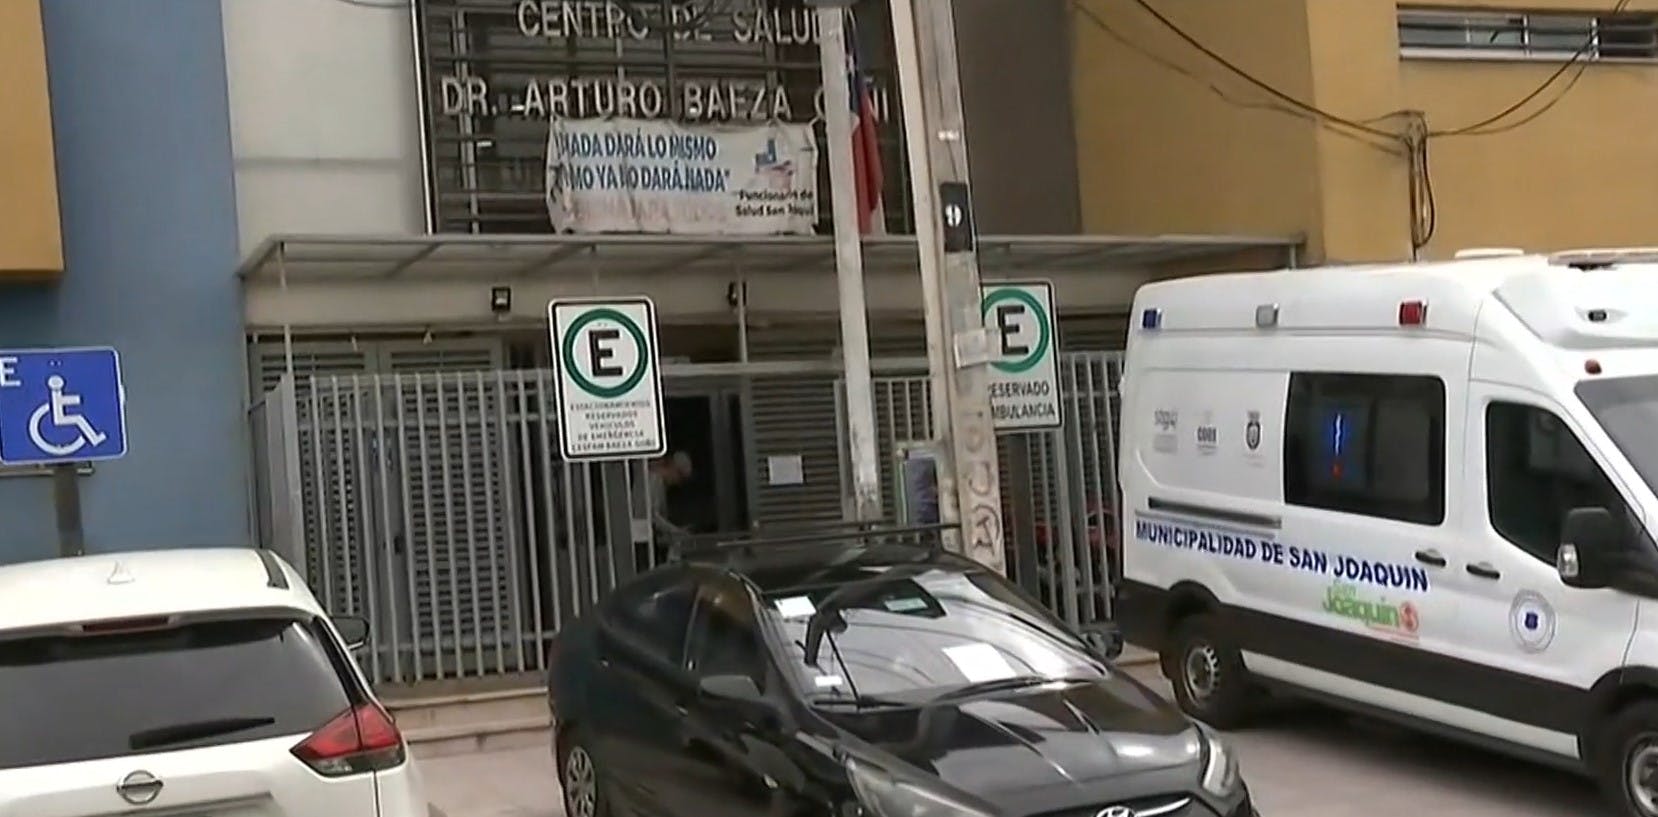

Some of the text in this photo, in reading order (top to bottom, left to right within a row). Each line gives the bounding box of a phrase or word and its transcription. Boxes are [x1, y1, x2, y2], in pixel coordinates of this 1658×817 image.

[518, 0, 649, 39] CENTRO
[672, 4, 712, 41] DE
[441, 77, 497, 116] DR.
[524, 77, 661, 118] ARTURO
[684, 80, 792, 121] BAEZA
[605, 127, 645, 158] DARÁ
[647, 133, 667, 158] LO
[597, 164, 619, 189] YA
[641, 160, 683, 190] DARÁ
[997, 304, 1029, 356] E
[588, 328, 624, 377] E
[990, 402, 1056, 420] MBULANCIA
[1136, 521, 1429, 592] MUNICIPALIDAD DE SAN JOAQUIN
